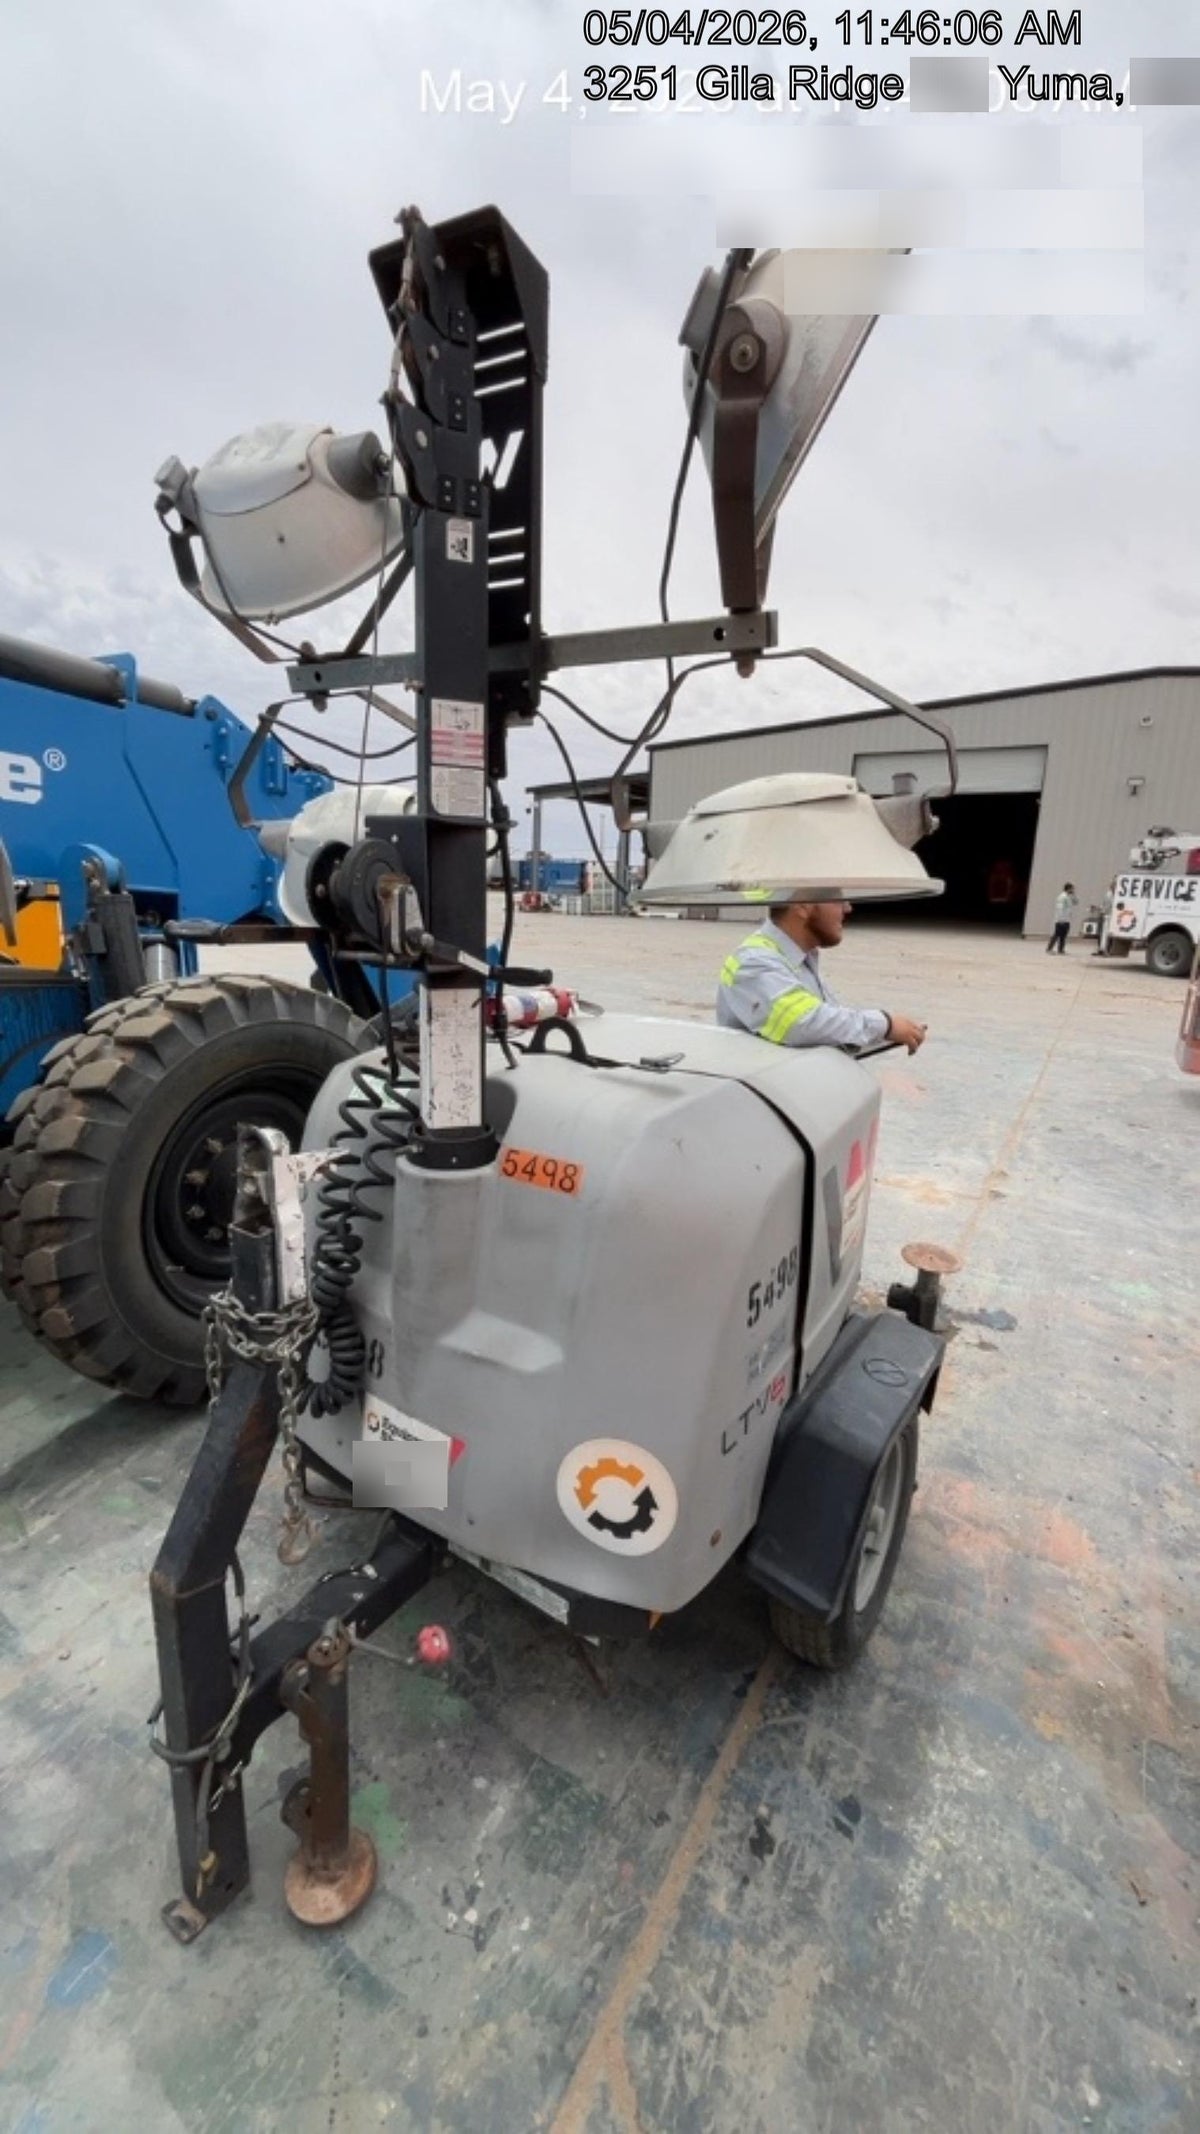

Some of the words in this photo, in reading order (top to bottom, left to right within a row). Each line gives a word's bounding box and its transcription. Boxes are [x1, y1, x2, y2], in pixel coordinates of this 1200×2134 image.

[1118, 877, 1198, 901] SERVICE
[502, 1149, 578, 1193] 5498
[747, 1245, 798, 1328] 5498
